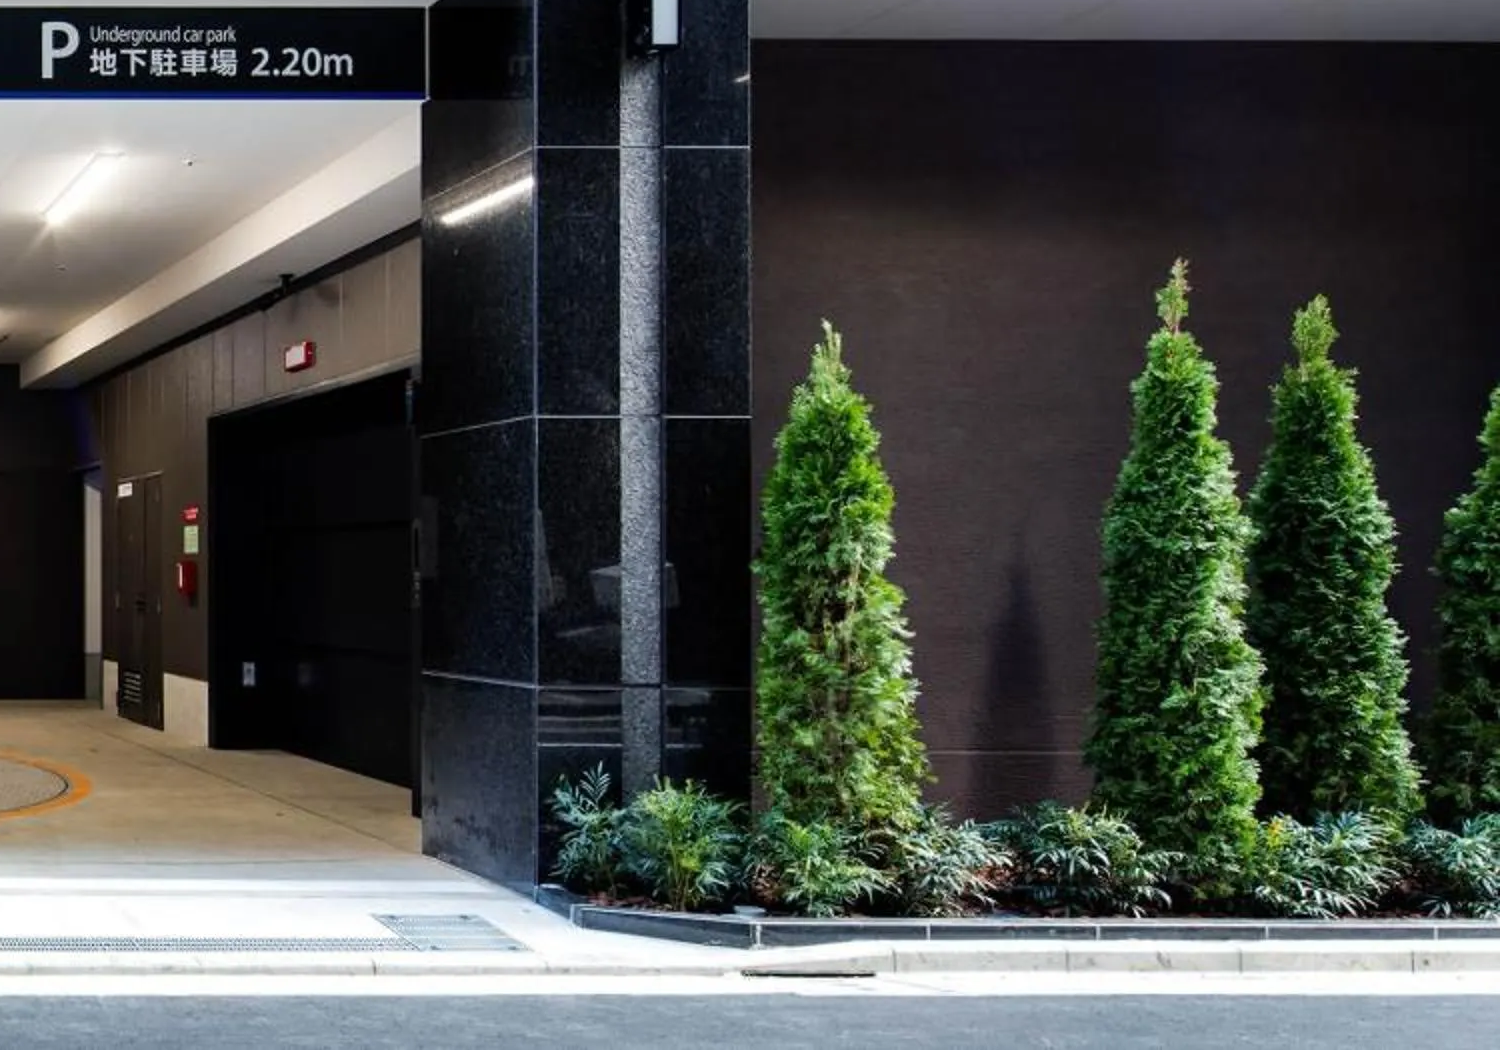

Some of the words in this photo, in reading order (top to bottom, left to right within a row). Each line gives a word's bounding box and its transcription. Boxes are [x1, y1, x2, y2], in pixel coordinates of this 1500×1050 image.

[41, 21, 80, 79] P
[90, 25, 181, 47] Underground
[183, 30, 204, 43] car
[206, 26, 237, 47] park
[89, 47, 239, 77] 地下駐車場
[251, 47, 353, 77] 2.20m
